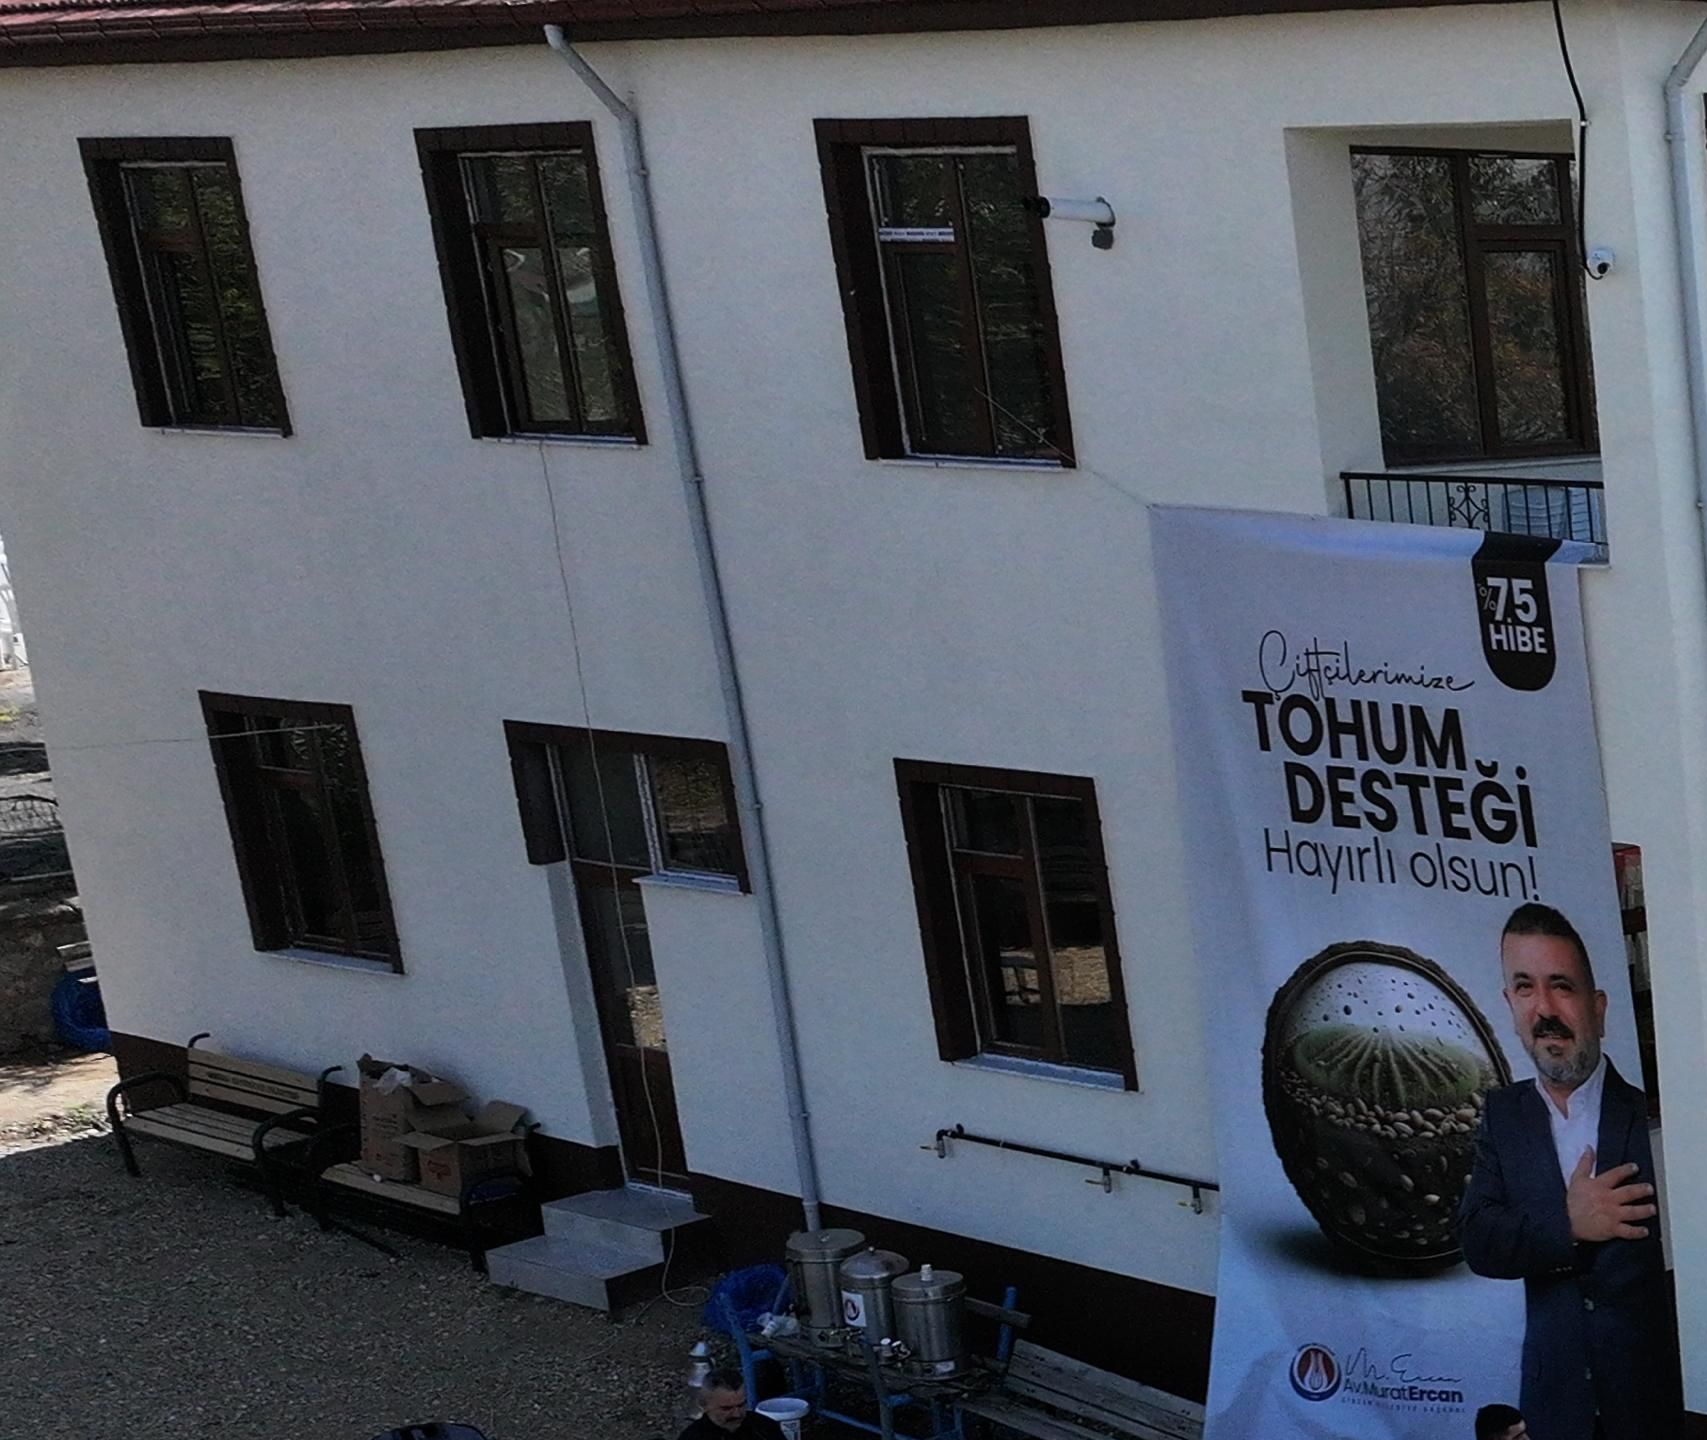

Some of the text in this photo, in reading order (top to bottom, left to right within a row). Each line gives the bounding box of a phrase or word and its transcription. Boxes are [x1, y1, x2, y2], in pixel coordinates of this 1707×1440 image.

[1258, 629, 1476, 701] Çiftçilerimize
[1488, 617, 1548, 655] HİBE
[1242, 690, 1466, 772] TOHUM
[1283, 760, 1539, 849] DESTEĞİ
[1263, 828, 1541, 902] Hayırlı olsun!
